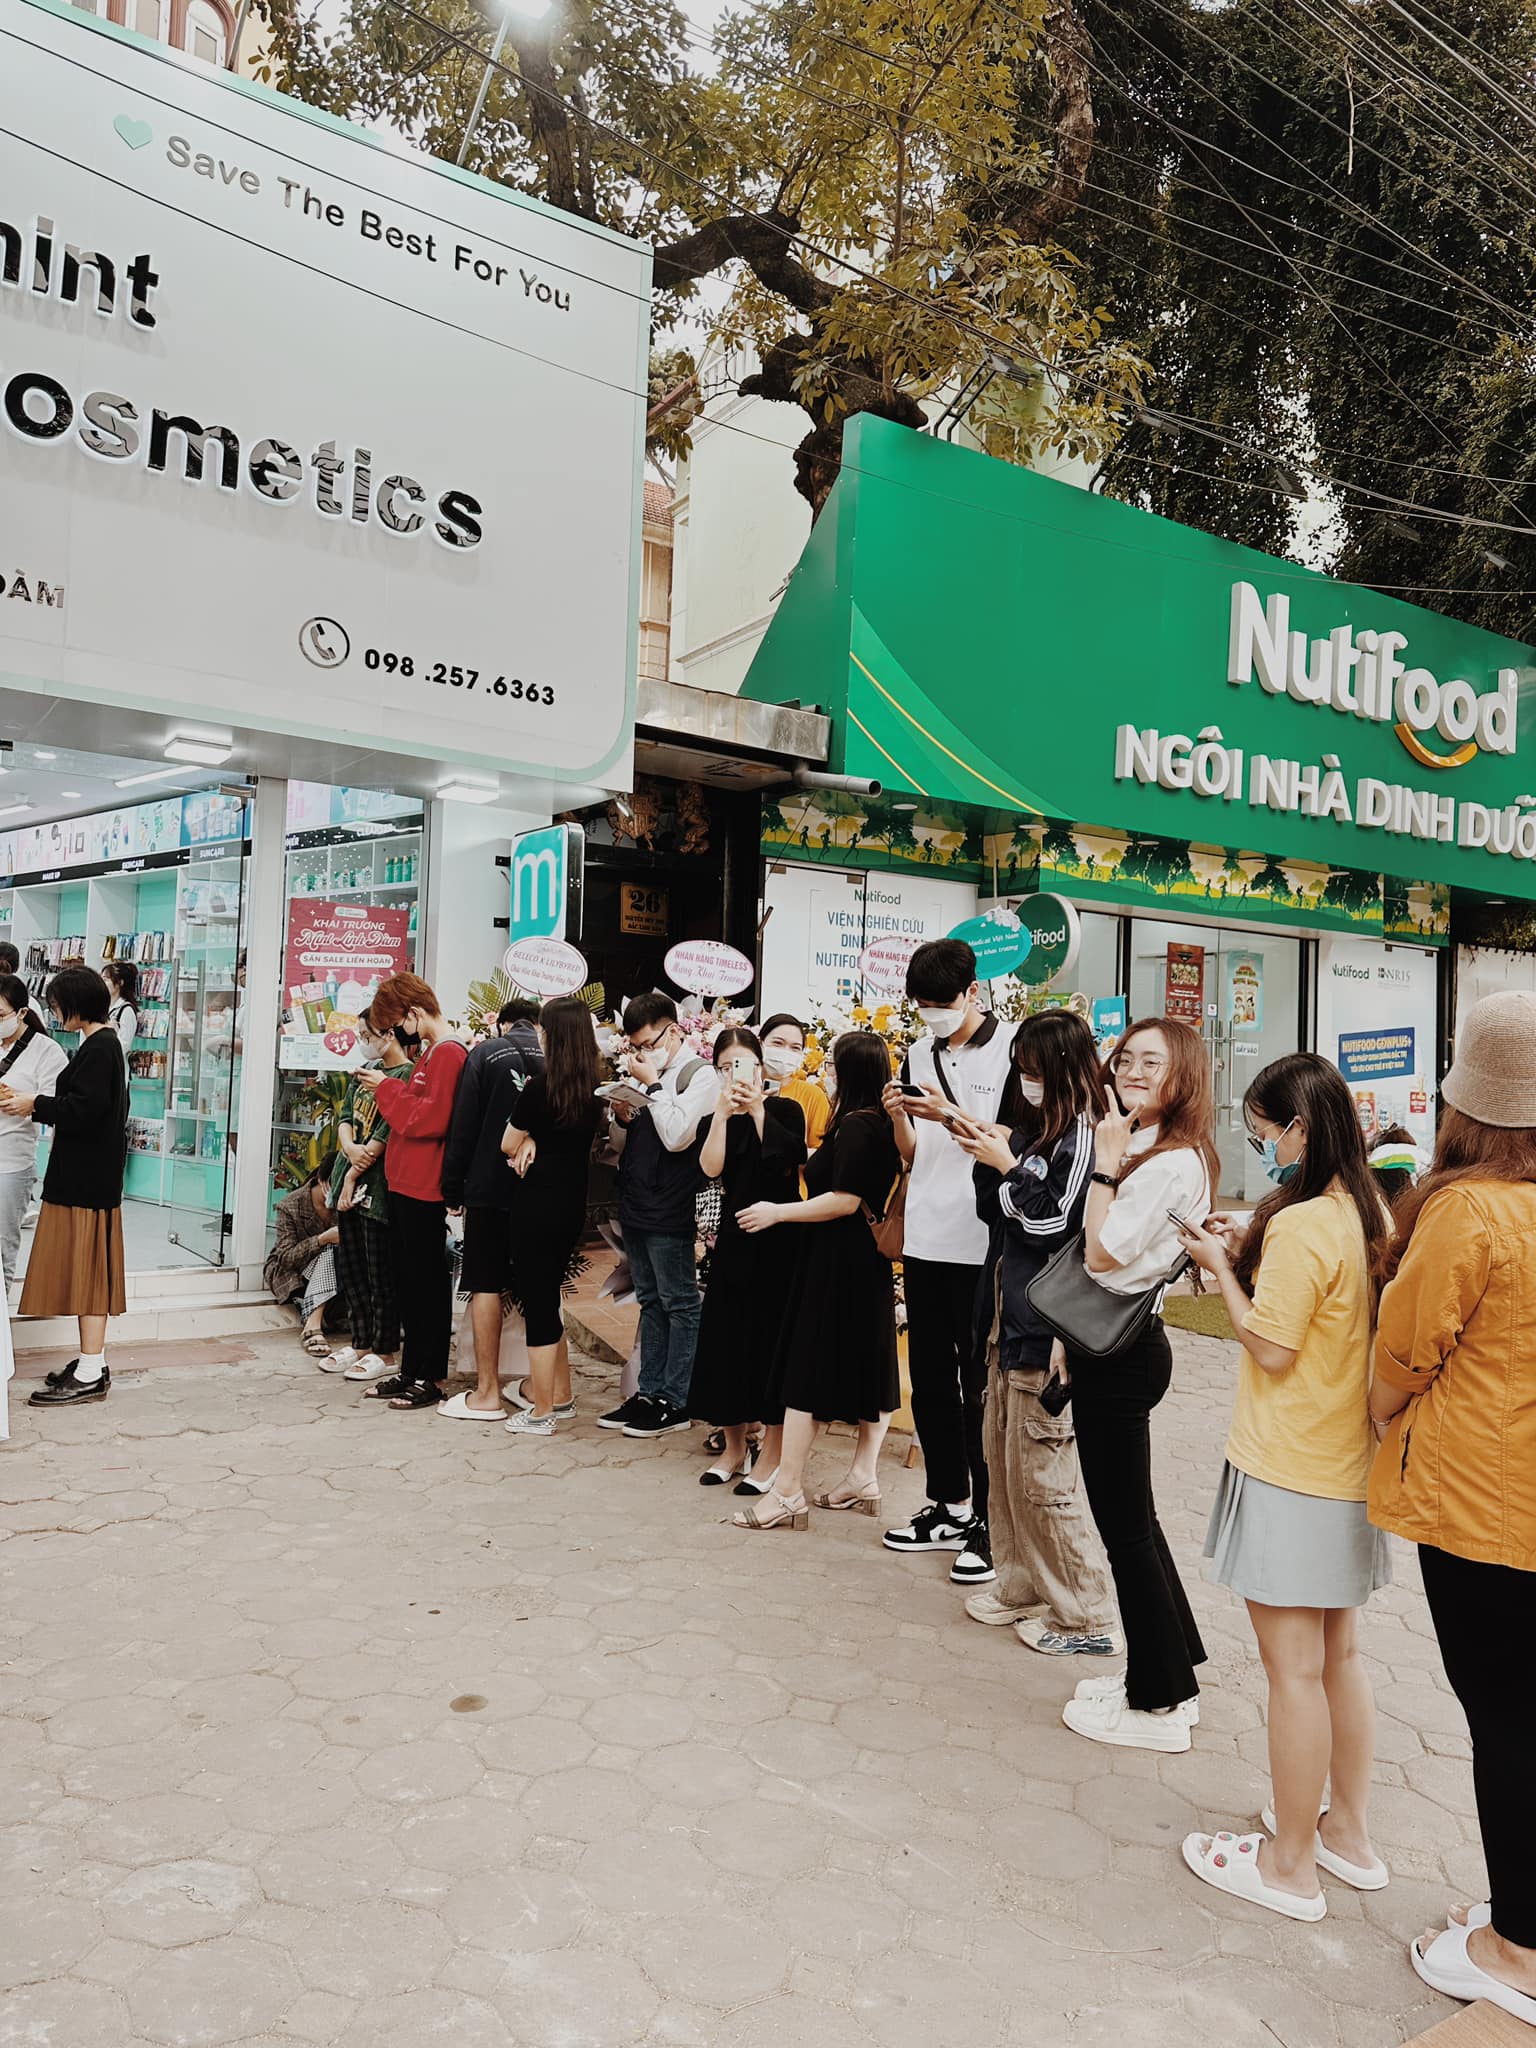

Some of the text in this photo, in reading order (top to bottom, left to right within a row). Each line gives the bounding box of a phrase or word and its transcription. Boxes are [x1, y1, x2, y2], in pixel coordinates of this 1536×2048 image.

[166, 136, 571, 312] Save The Best For You
[5, 373, 483, 549] osmetics
[364, 648, 555, 706] 098 .257 .6363
[1228, 581, 1517, 755] Nutifood
[1114, 724, 1536, 861] NGÔI NHÀ DINH DƯỠ
[513, 848, 558, 923] m
[854, 889, 901, 905] Nutifood
[313, 919, 340, 929] KHAI
[828, 910, 924, 934] VIỆN NGHIÊN CỨU
[1030, 924, 1066, 946] ifood
[716, 957, 749, 971] TIMELESS
[816, 952, 861, 969] NUTIFO
[334, 1040, 349, 1053] 14
